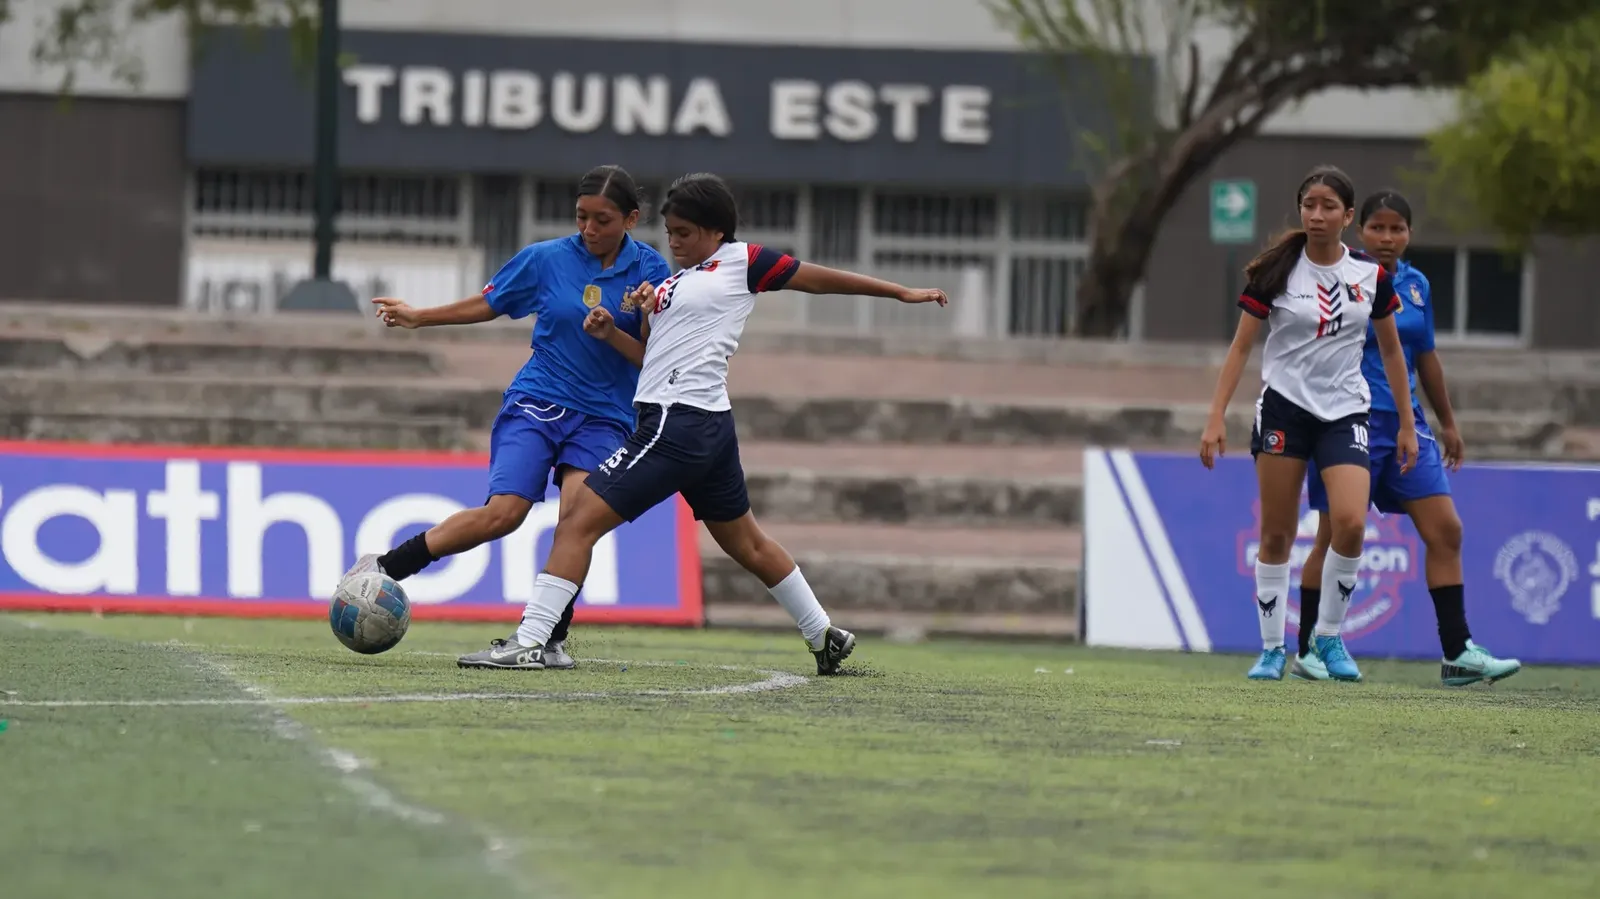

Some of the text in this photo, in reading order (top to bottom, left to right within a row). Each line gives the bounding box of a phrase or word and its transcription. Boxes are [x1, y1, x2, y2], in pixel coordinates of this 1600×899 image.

[342, 64, 992, 144] TRIBUNA ESTE
[1351, 423, 1369, 447] 10
[0, 459, 620, 605] athon
